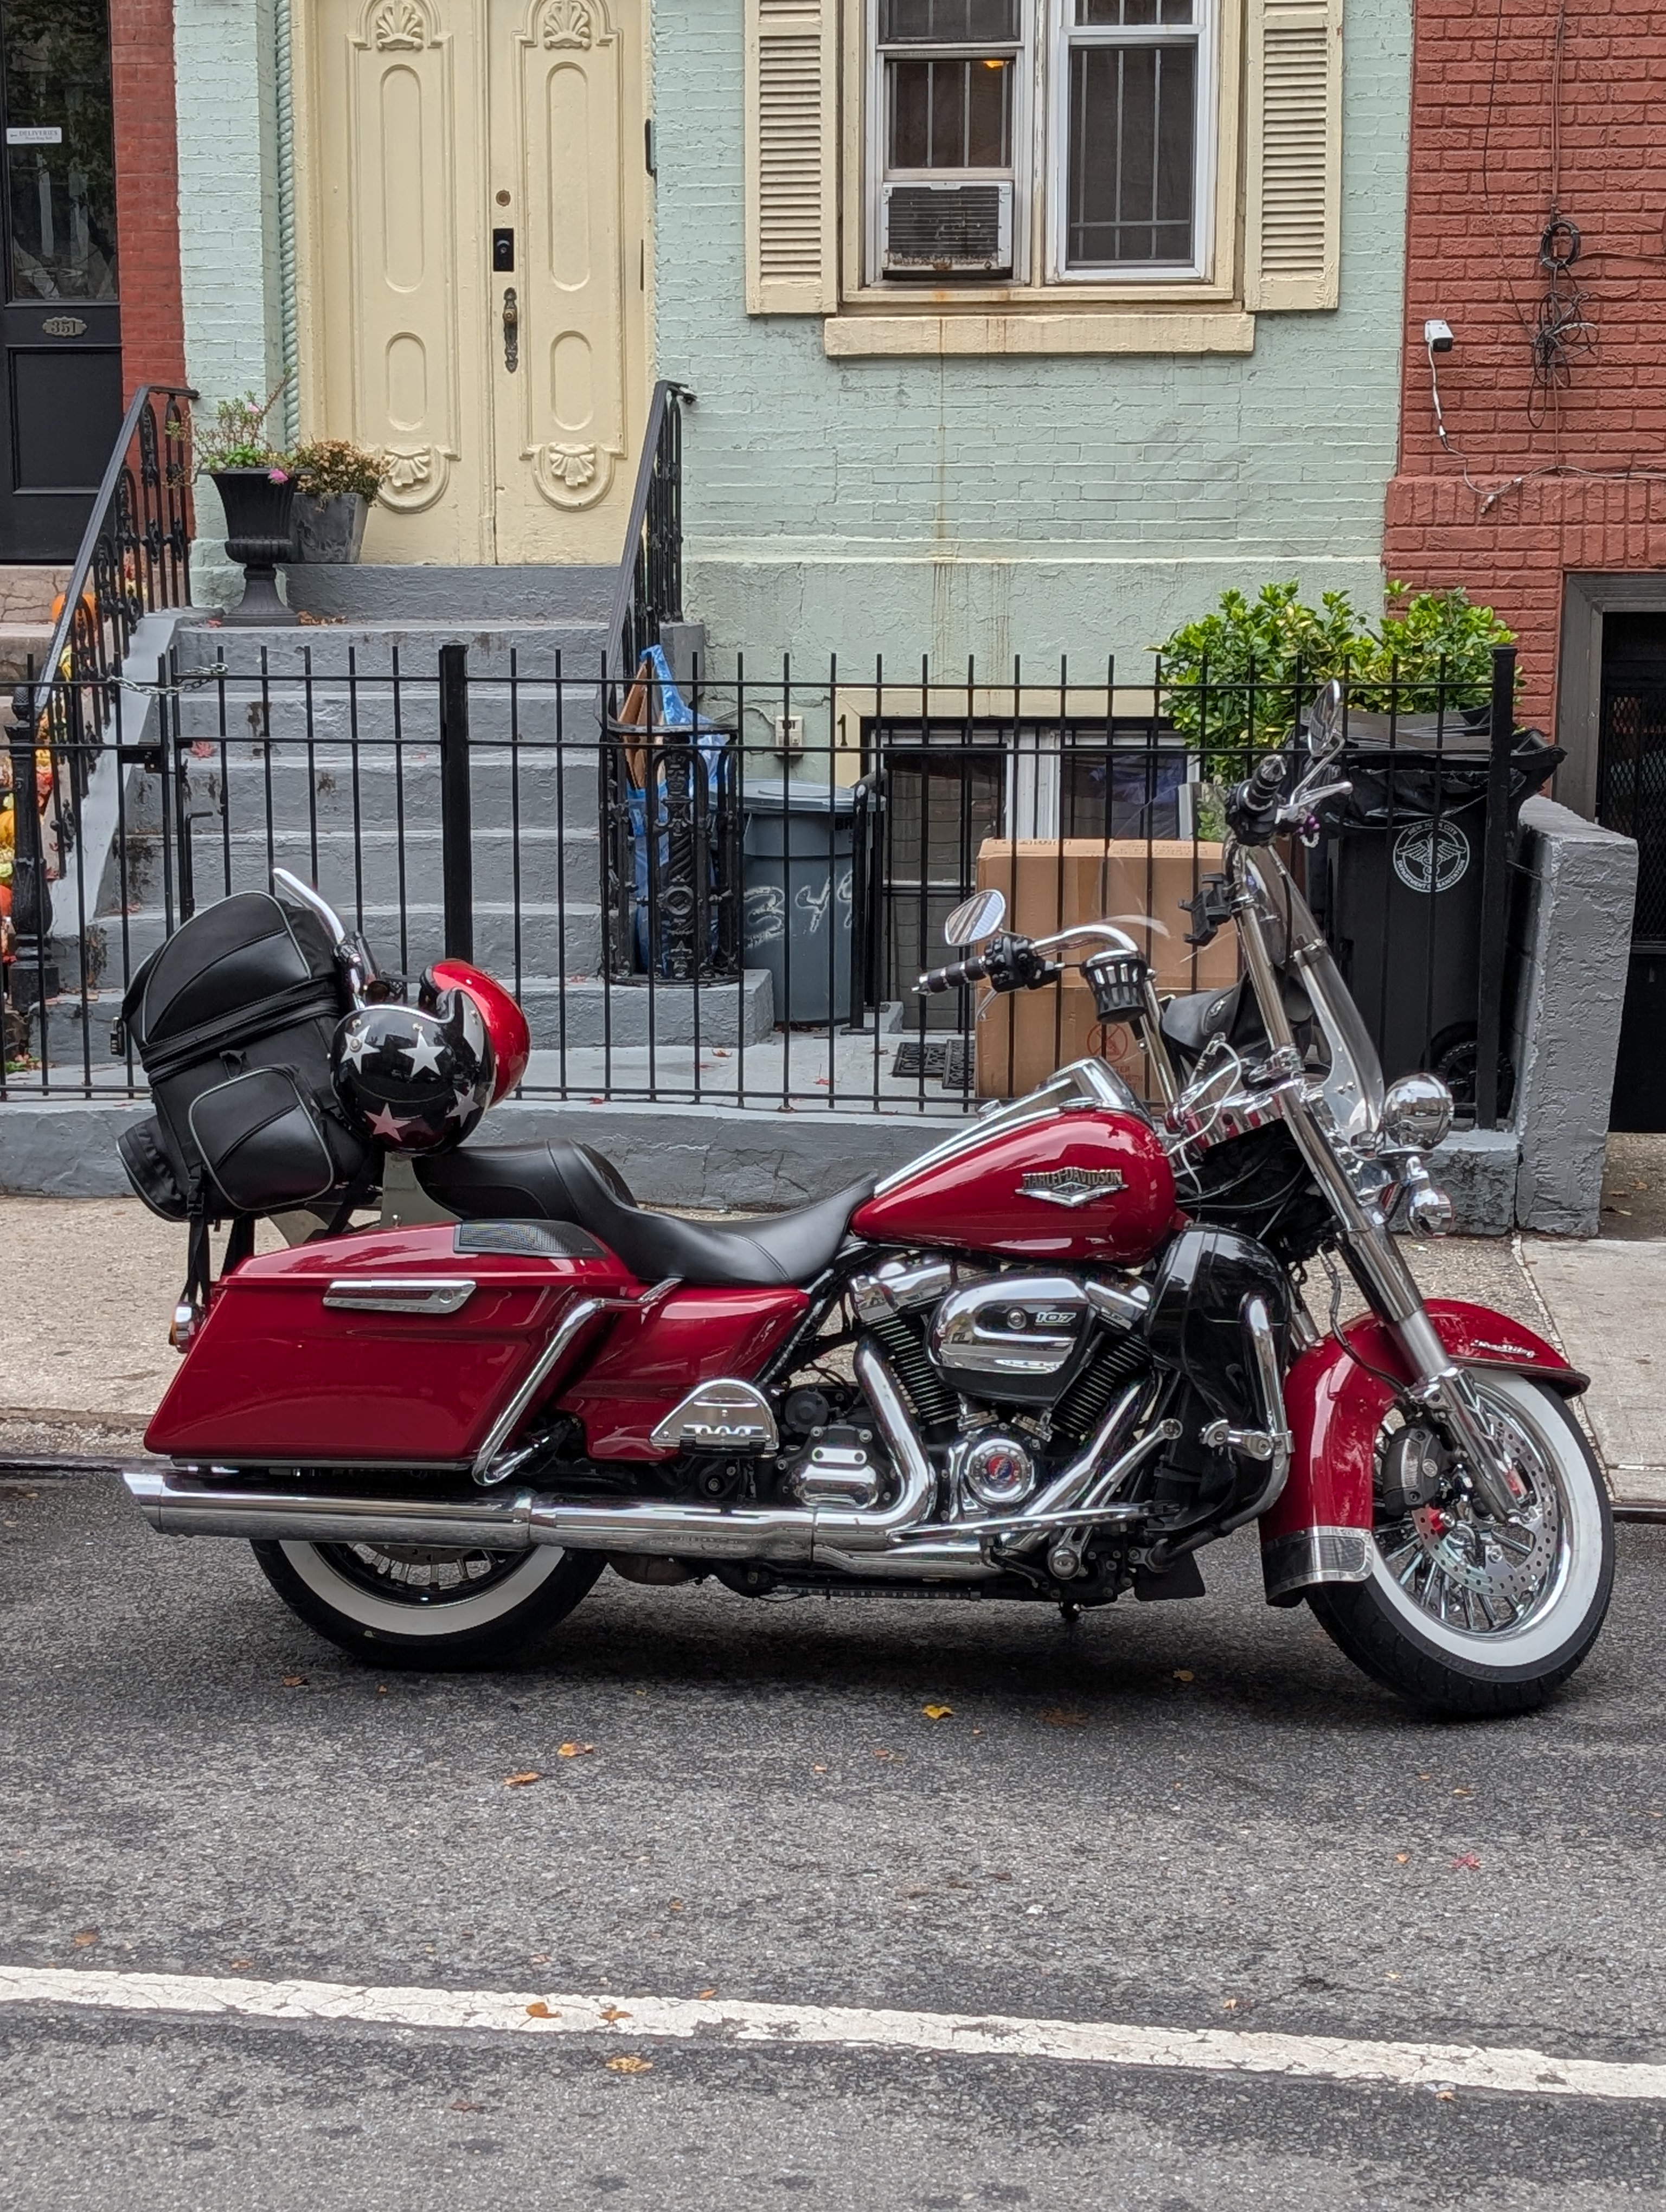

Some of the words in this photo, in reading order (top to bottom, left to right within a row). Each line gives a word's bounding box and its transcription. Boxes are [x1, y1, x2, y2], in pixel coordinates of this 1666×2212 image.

[51, 321, 76, 333] 351
[837, 714, 848, 747] 1
[1444, 824, 1458, 835] CITY
[1396, 859, 1426, 889] DEPARTMENT
[1436, 859, 1465, 889] SANITATION
[1022, 1167, 1123, 1187] HARLEY-DAVIDSON
[1035, 1312, 1077, 1323] 107
